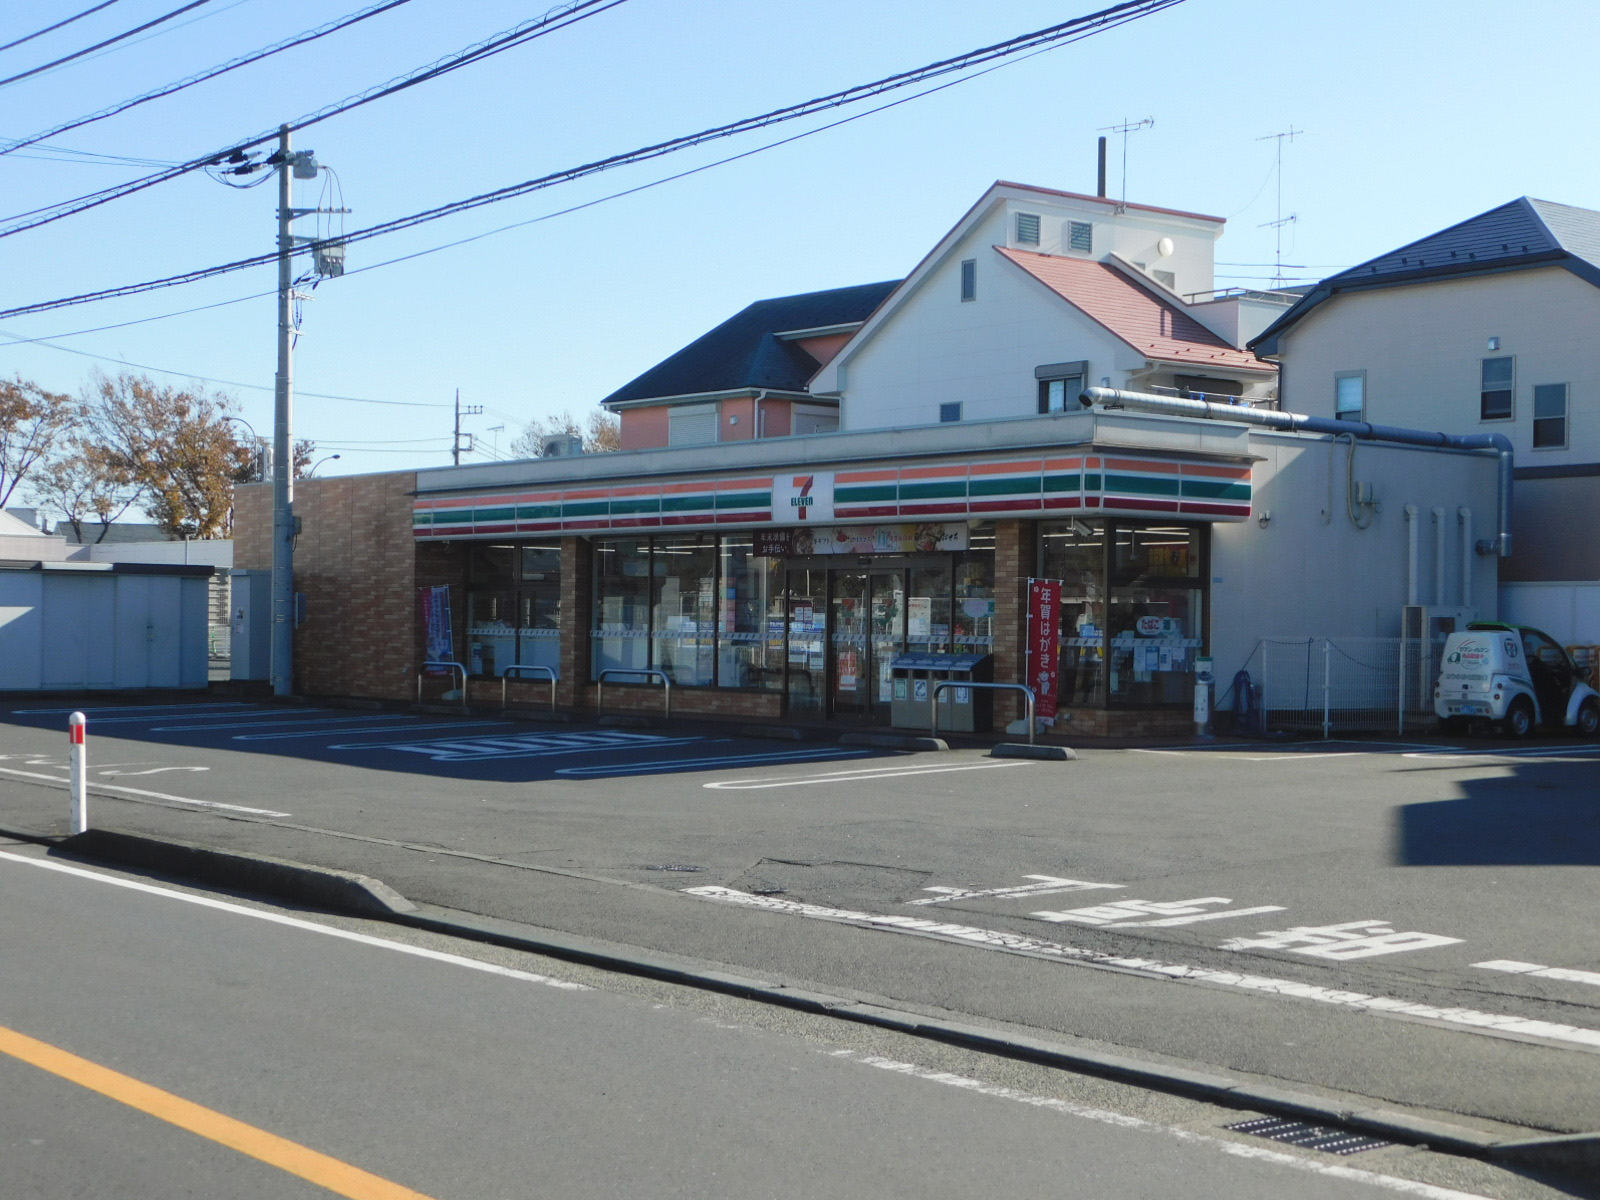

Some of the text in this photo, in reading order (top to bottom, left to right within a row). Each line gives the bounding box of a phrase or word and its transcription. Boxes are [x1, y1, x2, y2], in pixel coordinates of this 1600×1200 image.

[791, 496, 813, 506] ELEVEN
[793, 475, 813, 520] 7
[1040, 587, 1051, 668] 年賀はがき
[1142, 619, 1159, 630] たばこ
